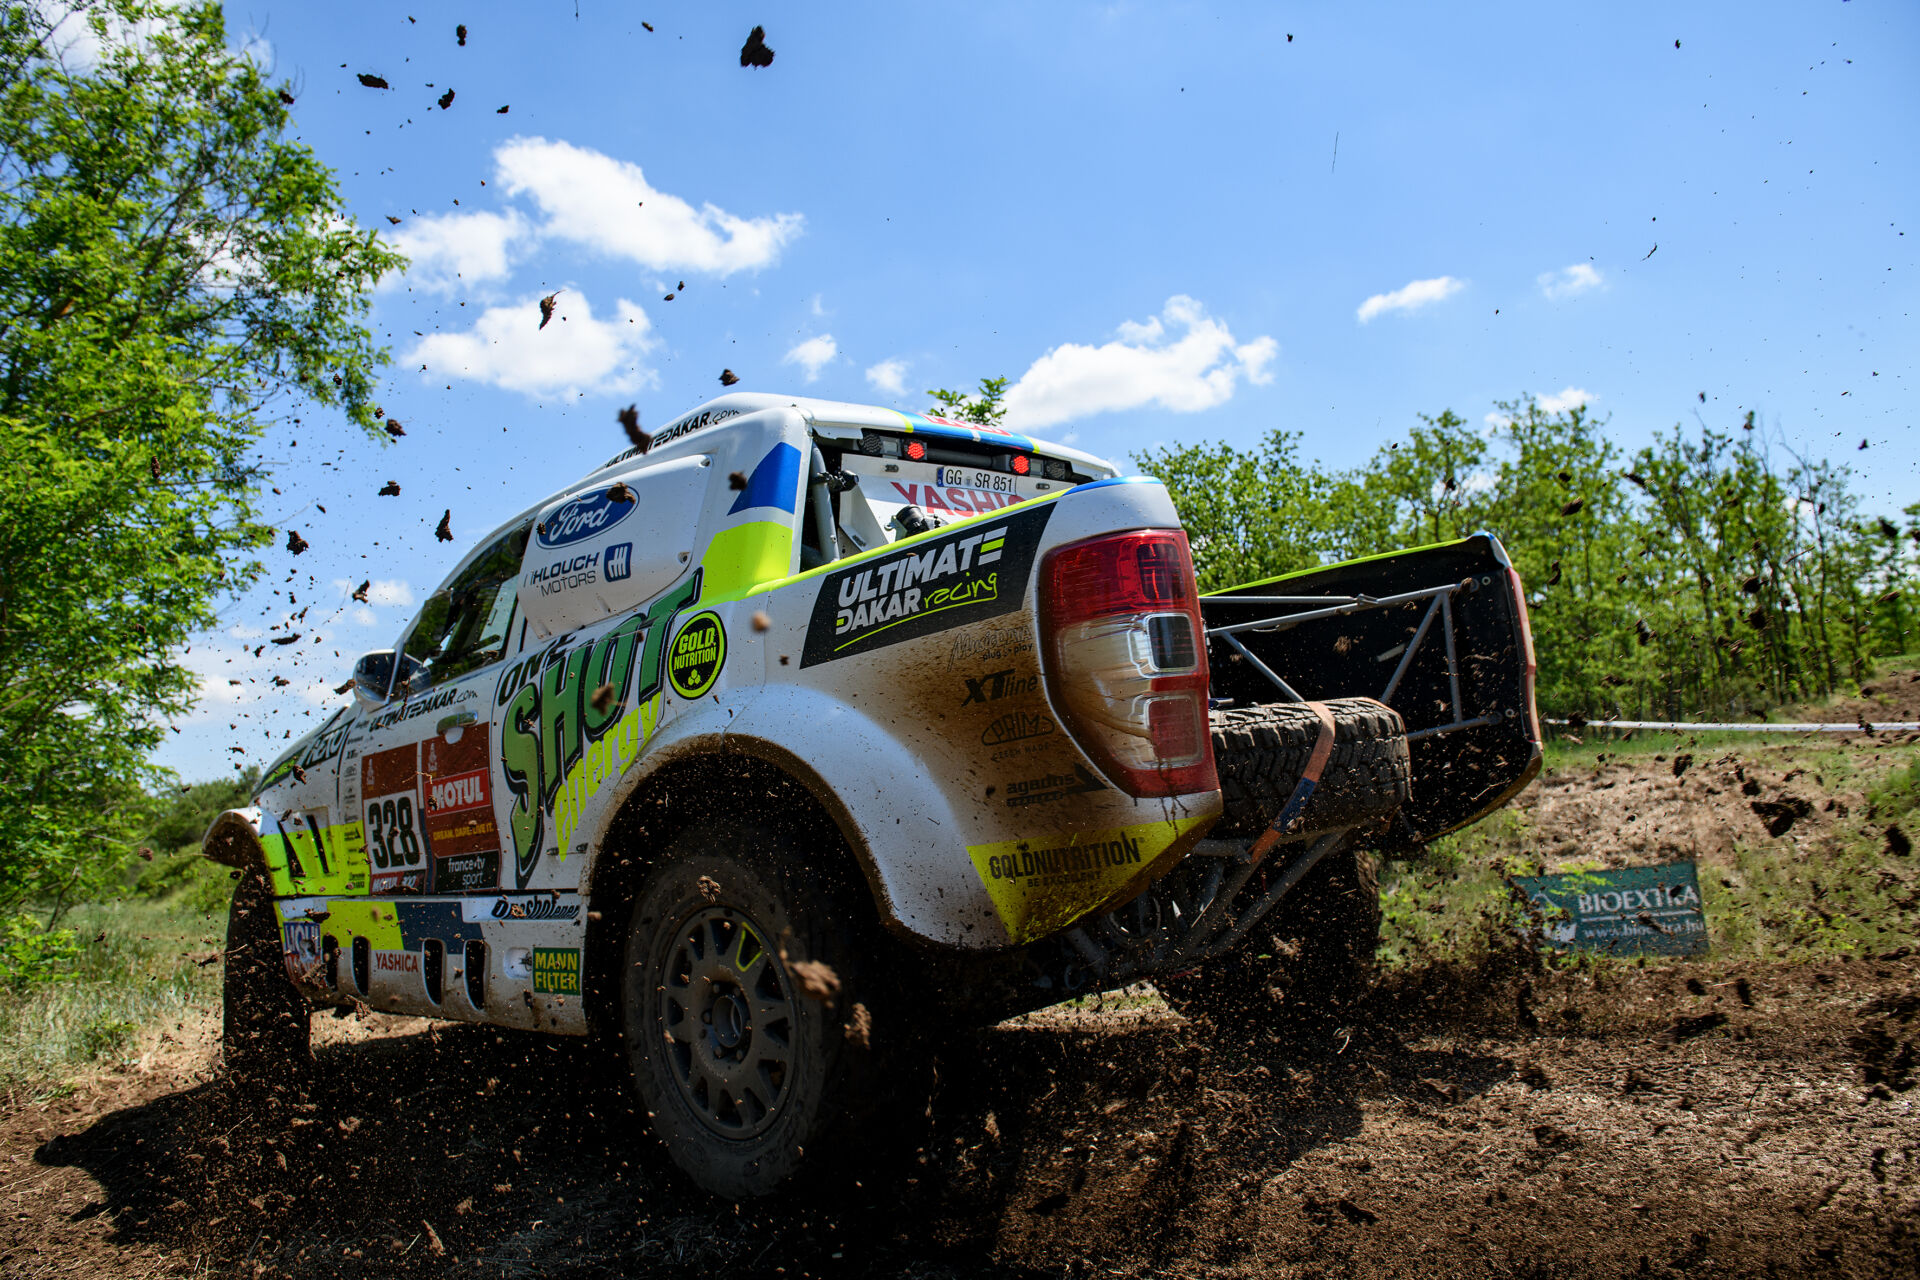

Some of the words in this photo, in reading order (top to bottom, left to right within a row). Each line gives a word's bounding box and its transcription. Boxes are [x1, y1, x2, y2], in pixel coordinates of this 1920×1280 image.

[946, 469, 962, 486] GG
[975, 473, 991, 489] SR
[993, 476, 1013, 493] 851
[549, 494, 611, 542] Ford
[532, 553, 600, 585] HLOUCH
[540, 571, 597, 597] MOTORS
[838, 526, 1008, 608] ULTIMATE
[836, 588, 921, 635] DAKAR
[923, 572, 998, 609] racing
[498, 632, 577, 706] ONE
[674, 647, 716, 671] NUTRITION
[961, 668, 1038, 707] XTline
[504, 567, 704, 889] SHOT
[991, 712, 1040, 741] PRIM
[432, 775, 484, 811] MOTUL
[554, 691, 661, 863] energy
[369, 796, 421, 870] 328
[989, 838, 1141, 880] GOLDNUTRITION
[462, 872, 484, 886] sport
[1027, 877, 1039, 888] BE
[376, 952, 419, 974] YASHICA
[535, 952, 578, 970] MANN
[535, 970, 578, 991] FILTER
